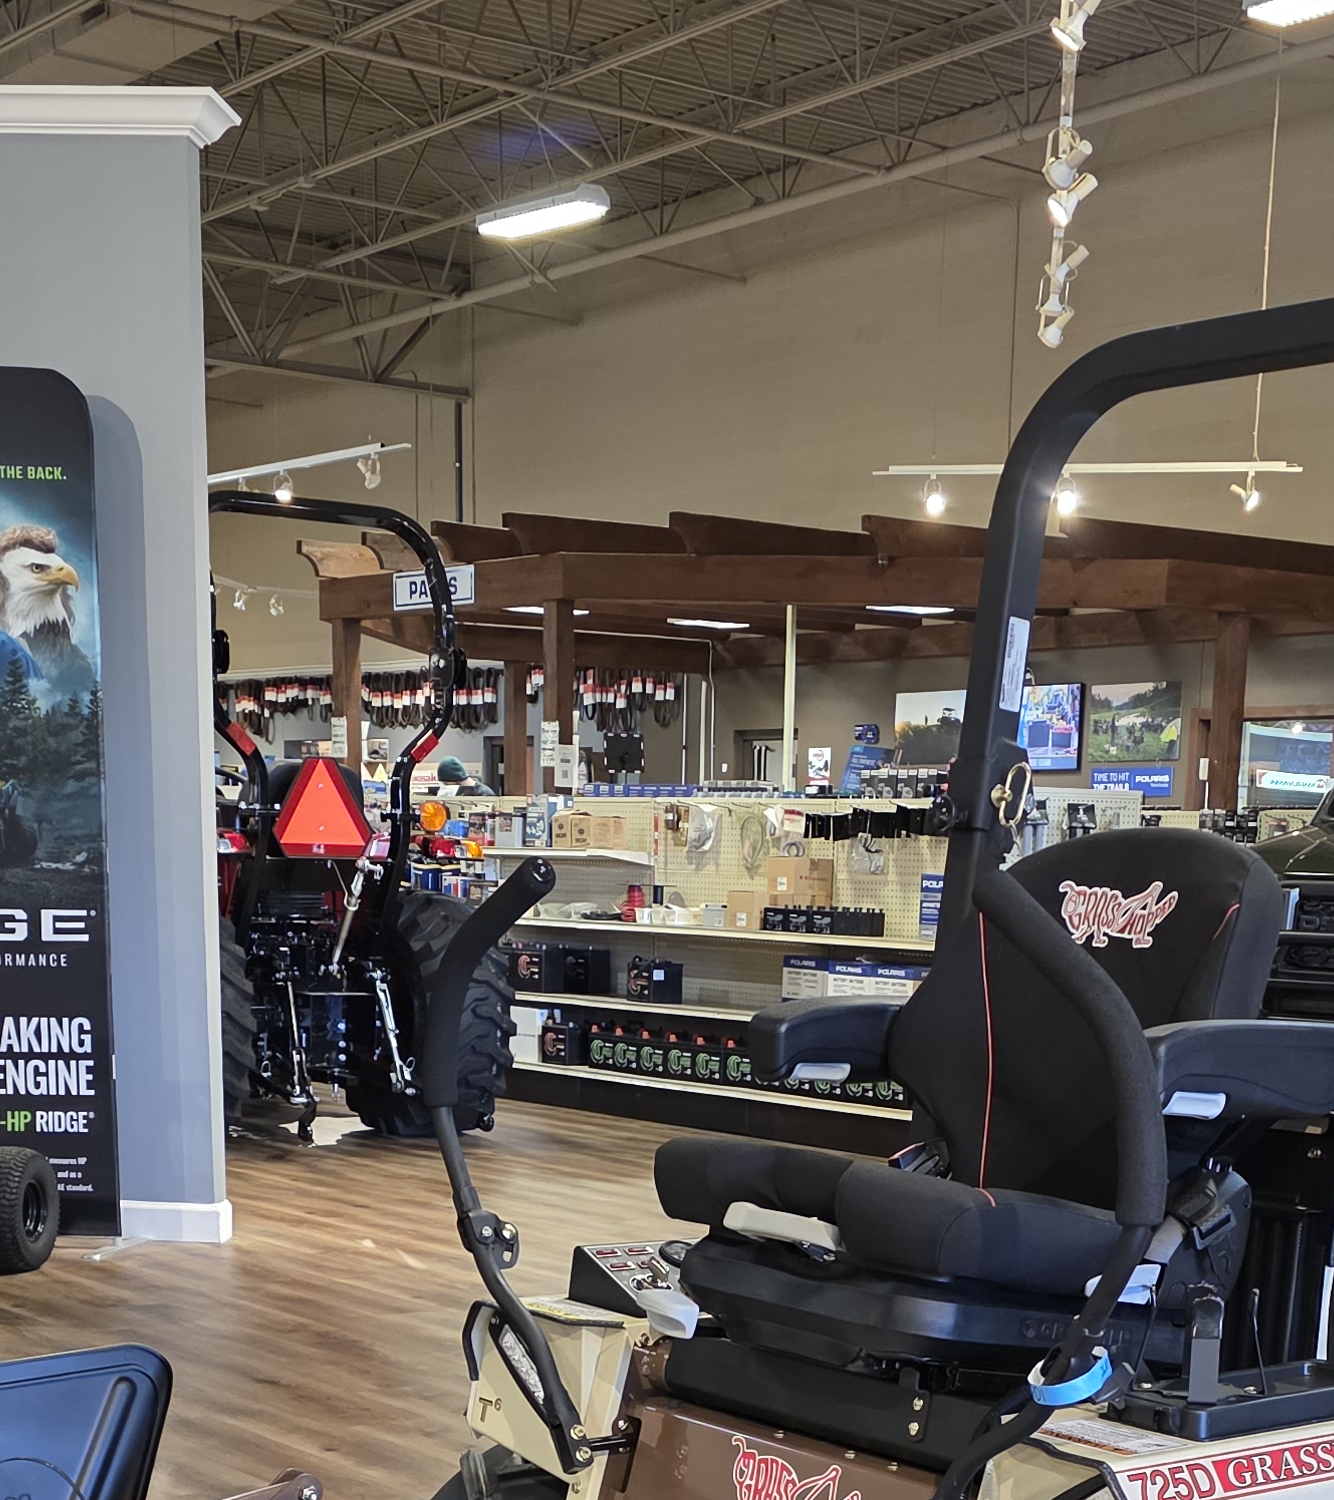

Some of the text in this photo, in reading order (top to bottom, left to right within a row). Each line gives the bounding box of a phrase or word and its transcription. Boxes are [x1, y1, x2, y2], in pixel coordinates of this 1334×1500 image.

[27, 466, 67, 480] BACK.
[409, 579, 458, 600] PAS
[1094, 772, 1130, 782] TIME TO HIT
[1136, 774, 1169, 783] POLARIS
[790, 959, 816, 967] POLARIS
[835, 965, 862, 974] POLARIS
[878, 968, 906, 977] POLARIS
[36, 1112, 89, 1132] RIDGE
